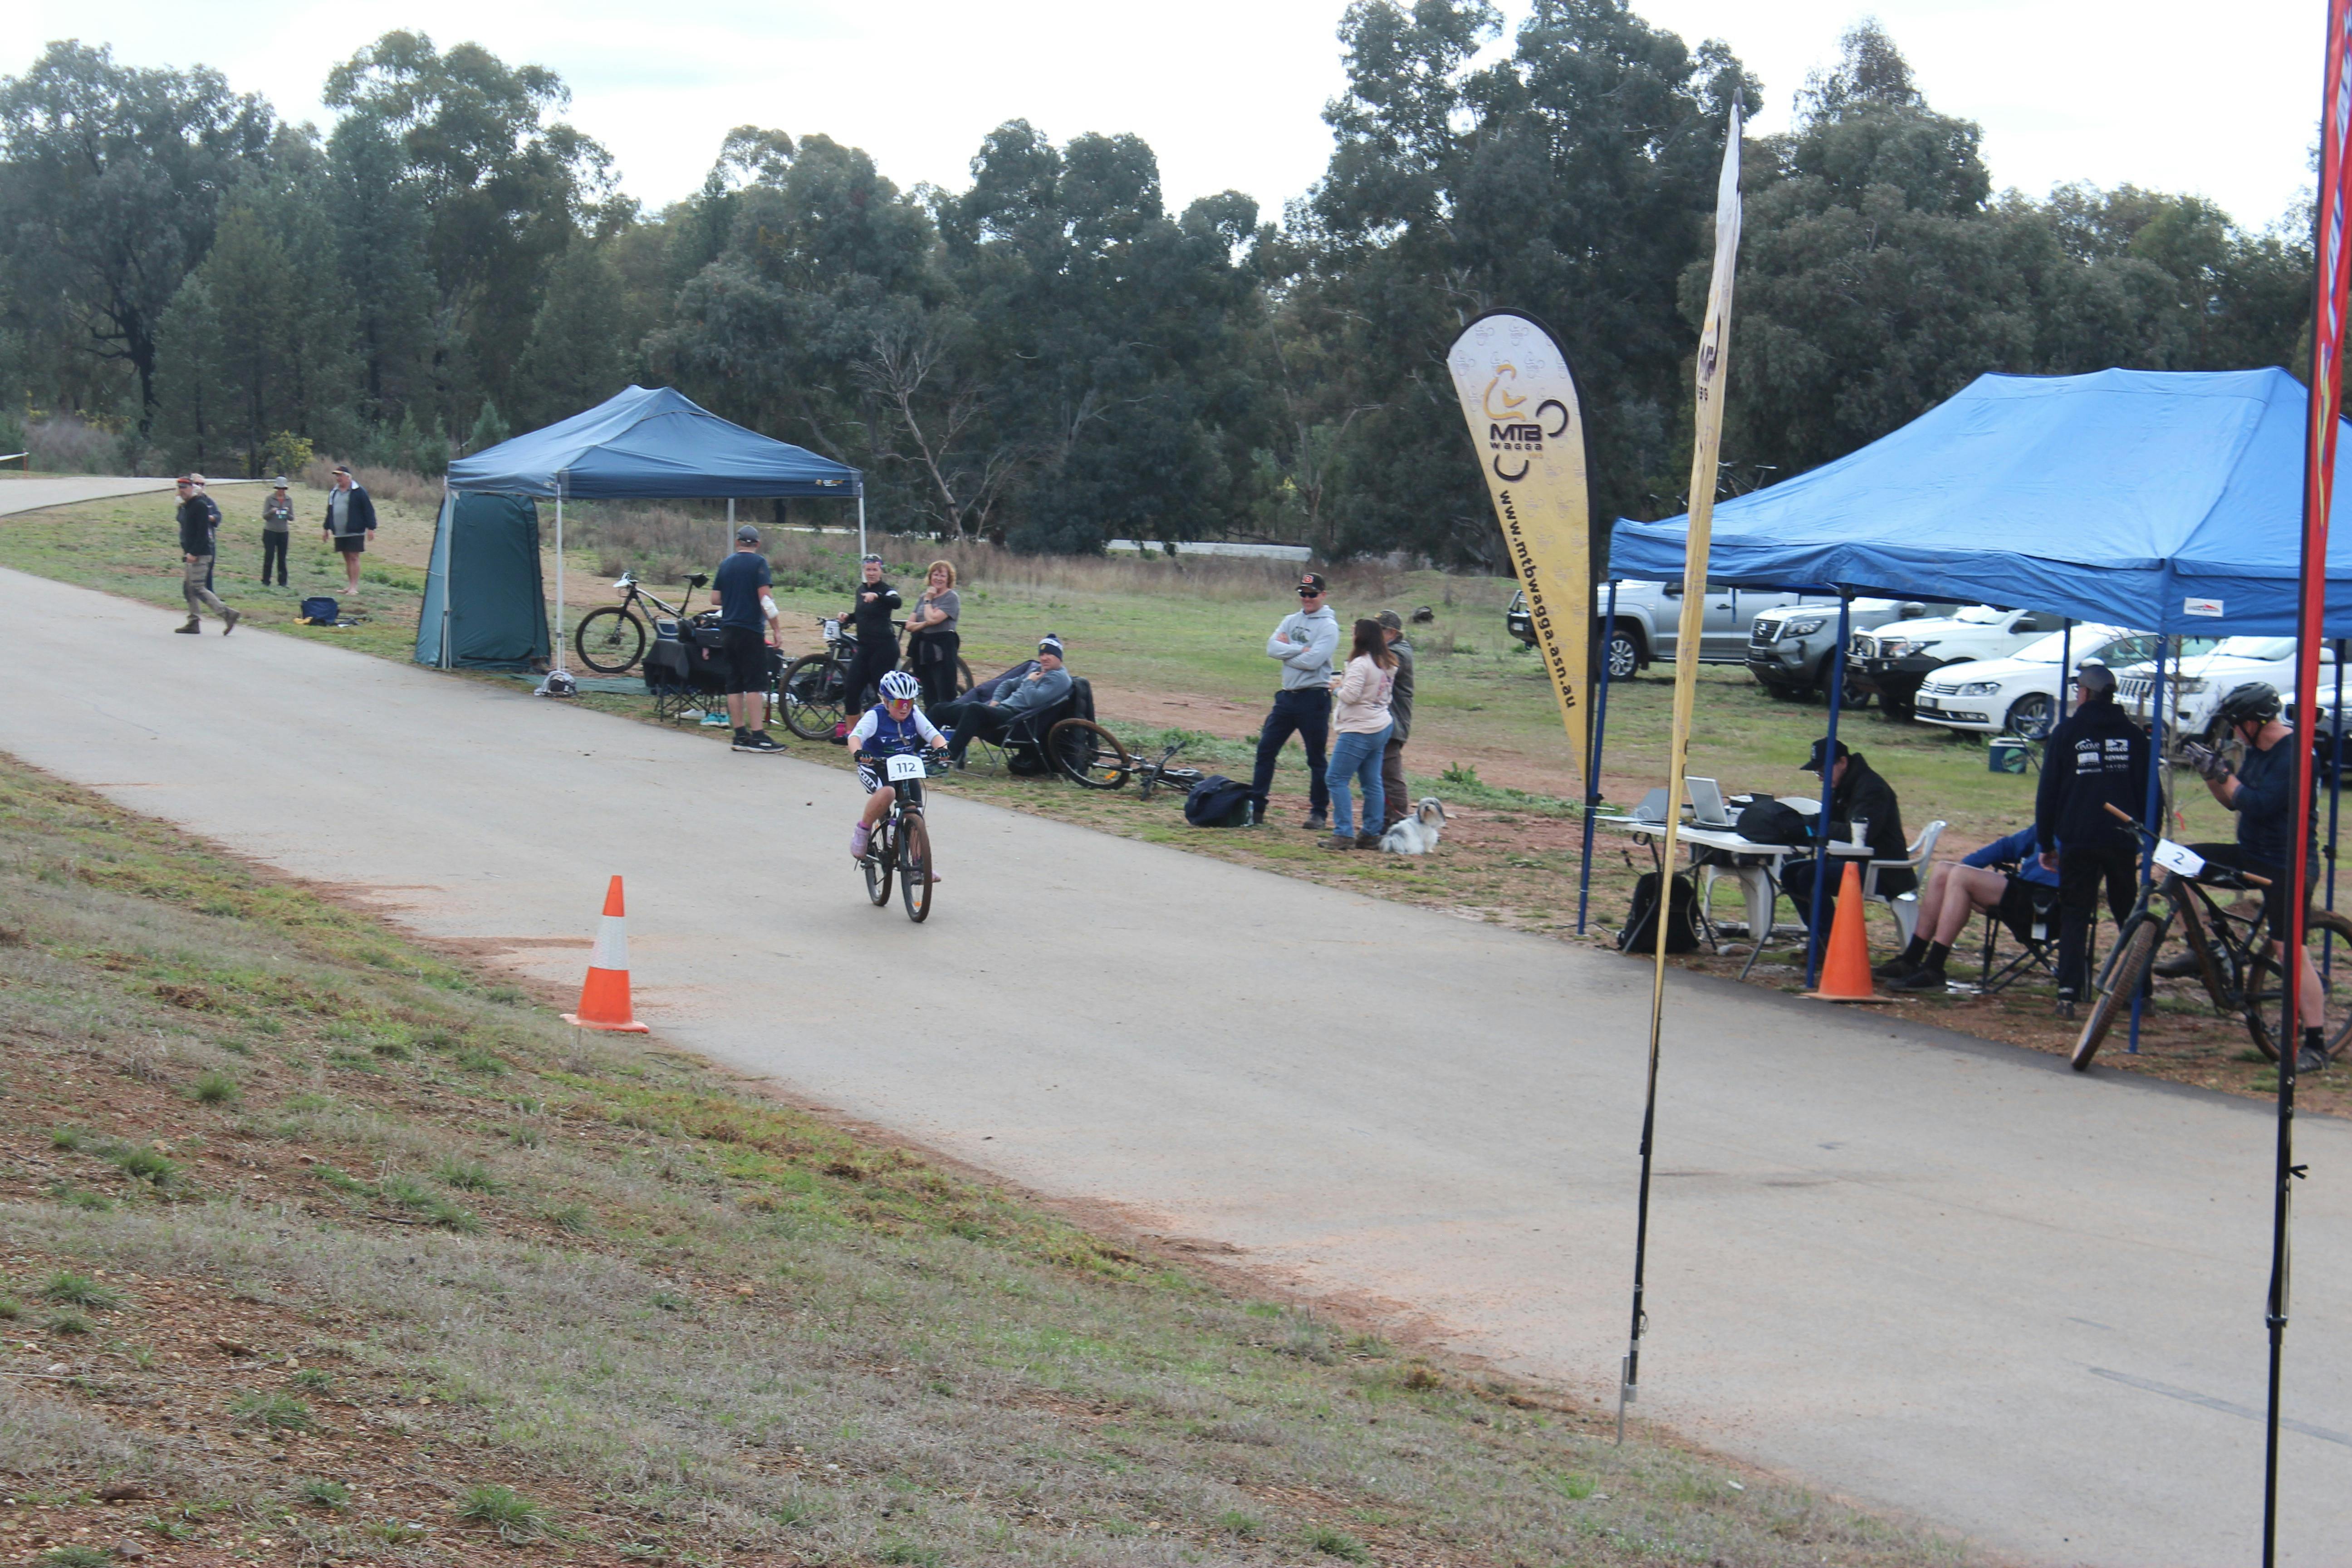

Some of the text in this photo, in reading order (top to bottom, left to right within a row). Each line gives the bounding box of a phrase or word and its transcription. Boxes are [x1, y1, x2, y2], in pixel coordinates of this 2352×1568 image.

[1490, 423, 1542, 441] MTB
[1499, 490, 1576, 709] www.mtbwagga.asn.au
[896, 762, 916, 773] 112
[2173, 852, 2185, 865] 2
